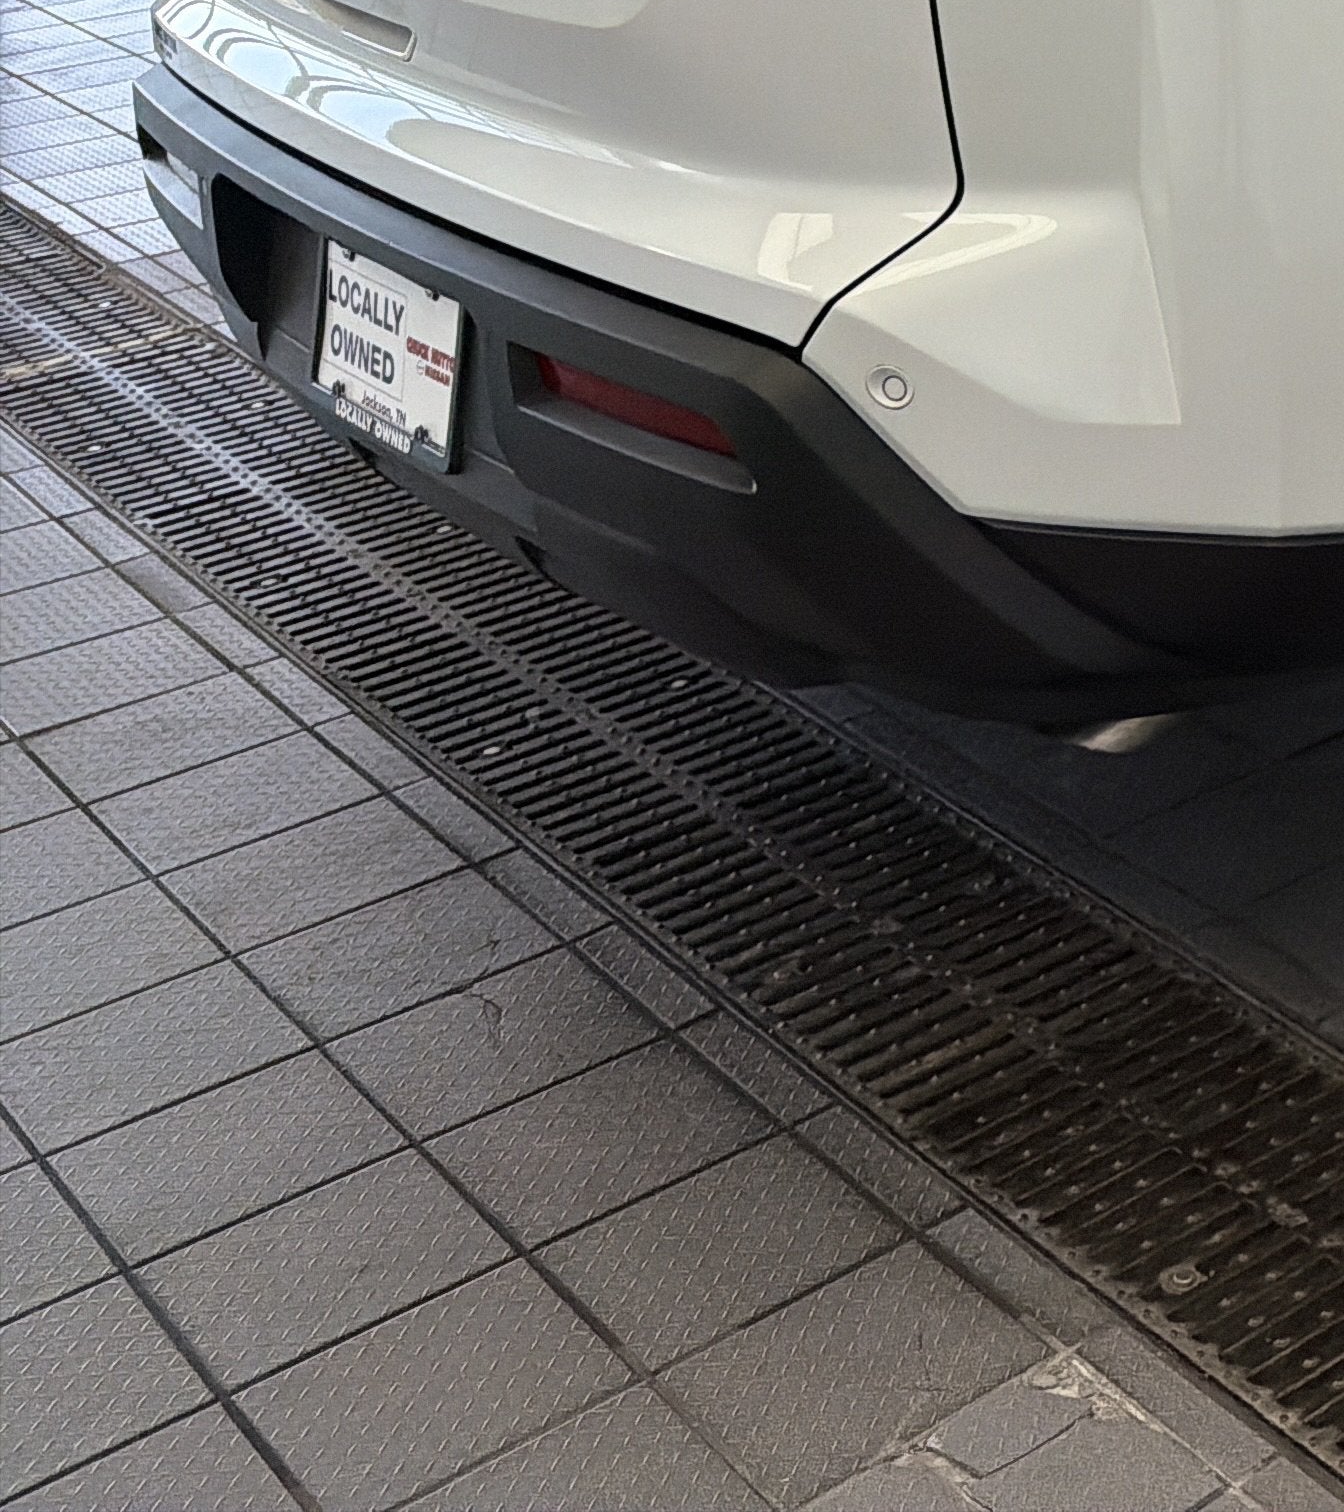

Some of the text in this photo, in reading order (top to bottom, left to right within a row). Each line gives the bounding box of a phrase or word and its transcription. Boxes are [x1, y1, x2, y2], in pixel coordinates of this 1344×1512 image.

[328, 268, 405, 337] LOCALLY
[330, 323, 395, 385] OWNED
[335, 397, 412, 454] LOCALLY OWNED
